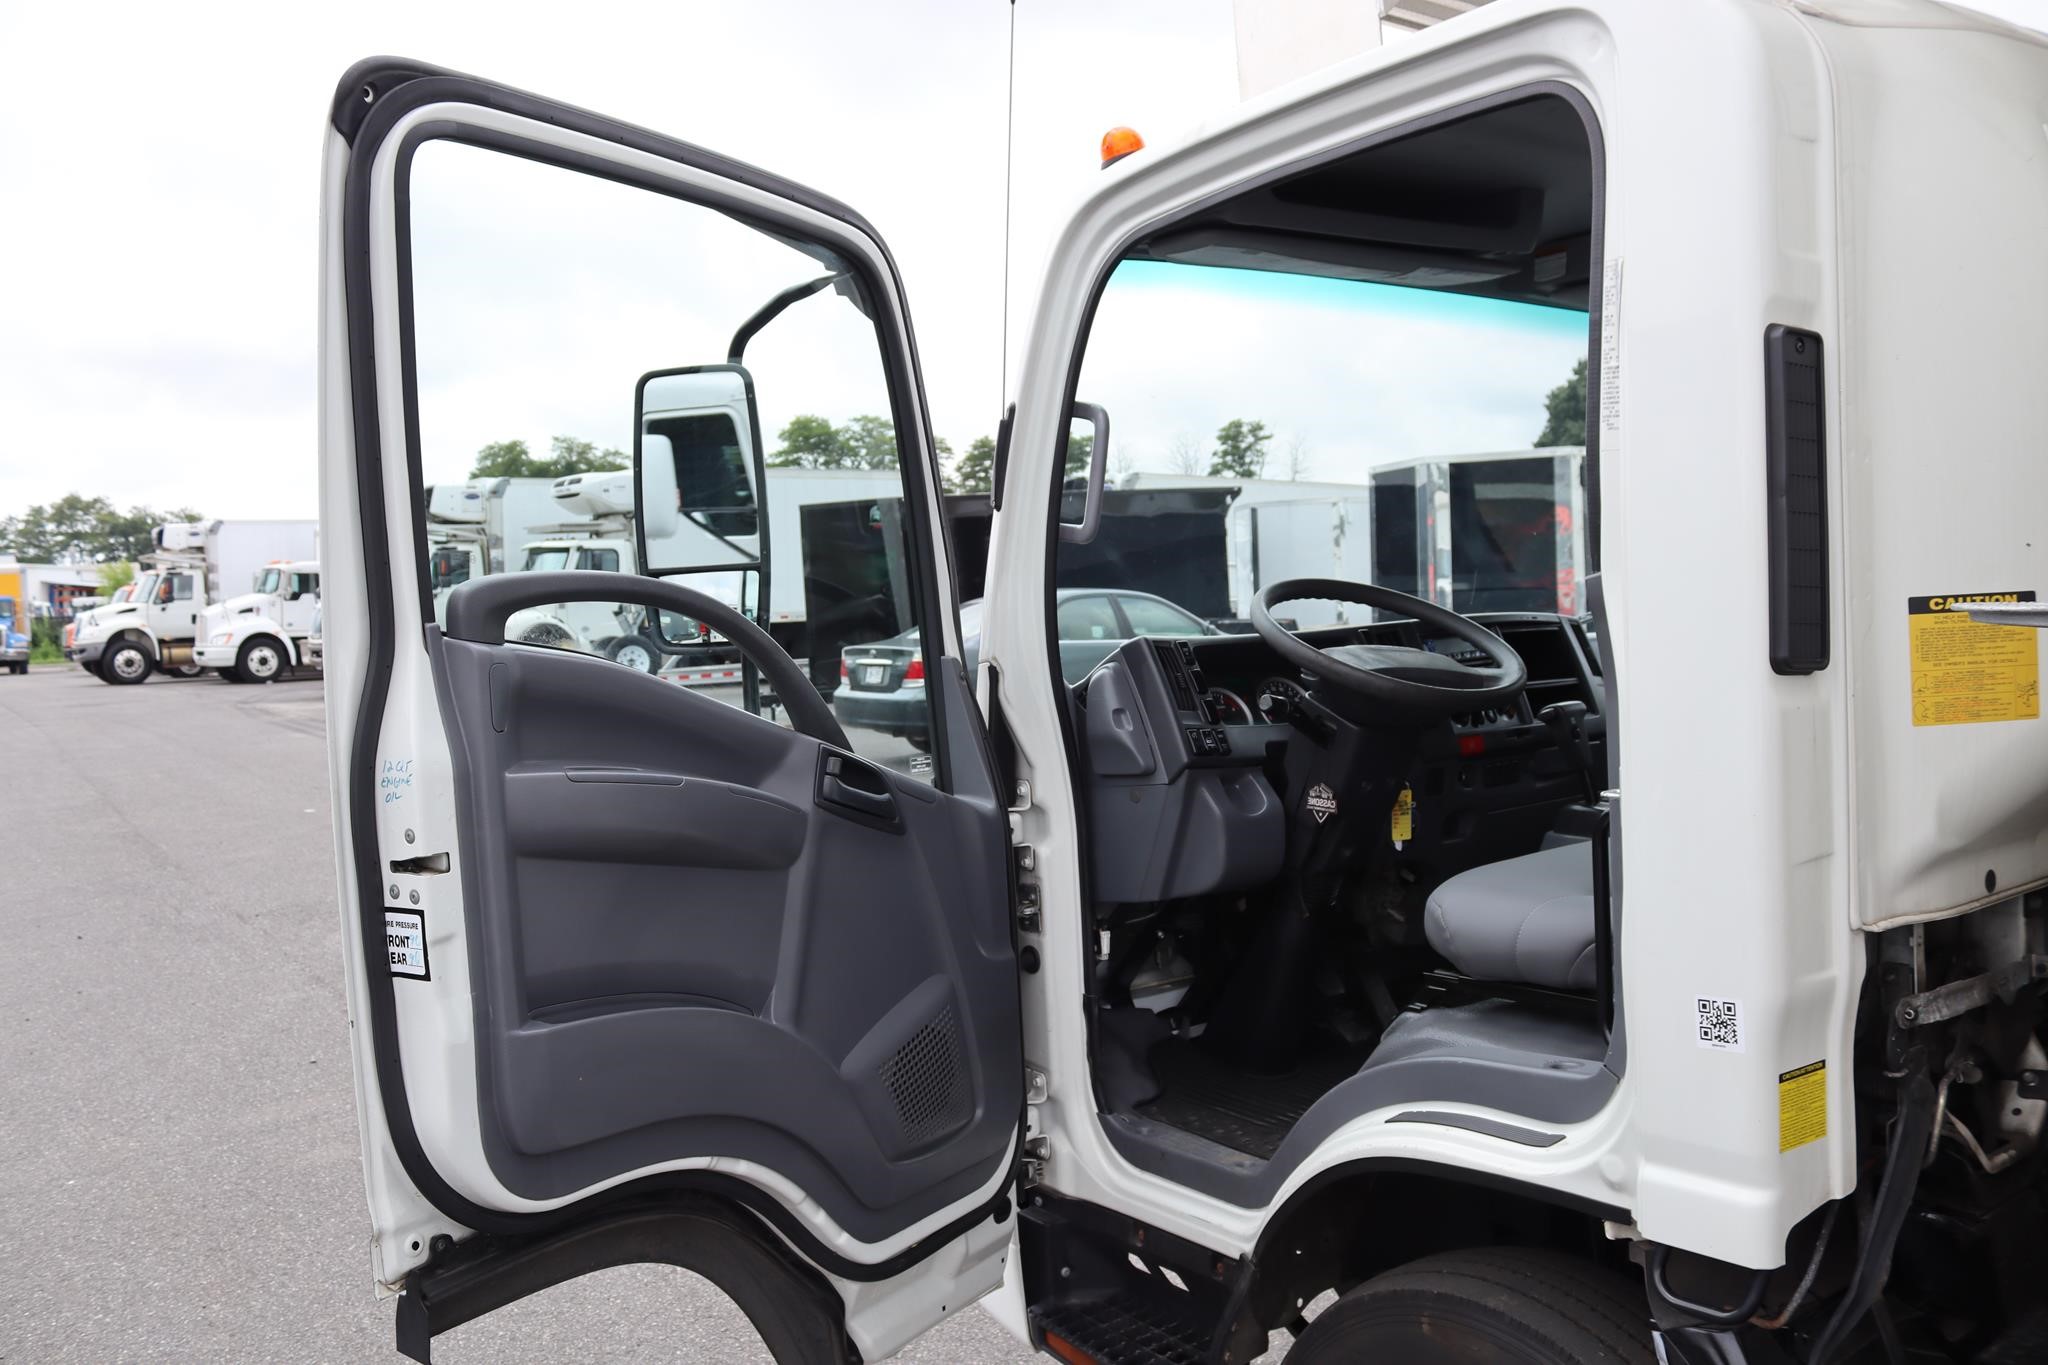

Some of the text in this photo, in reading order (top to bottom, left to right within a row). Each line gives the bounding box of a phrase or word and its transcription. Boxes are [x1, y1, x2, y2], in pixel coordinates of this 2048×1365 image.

[380, 773, 413, 789] ENGINE
[385, 791, 403, 804] OIL
[395, 921, 419, 930] PRESSURE
[386, 934, 410, 949] RONT
[390, 951, 408, 966] EAR
